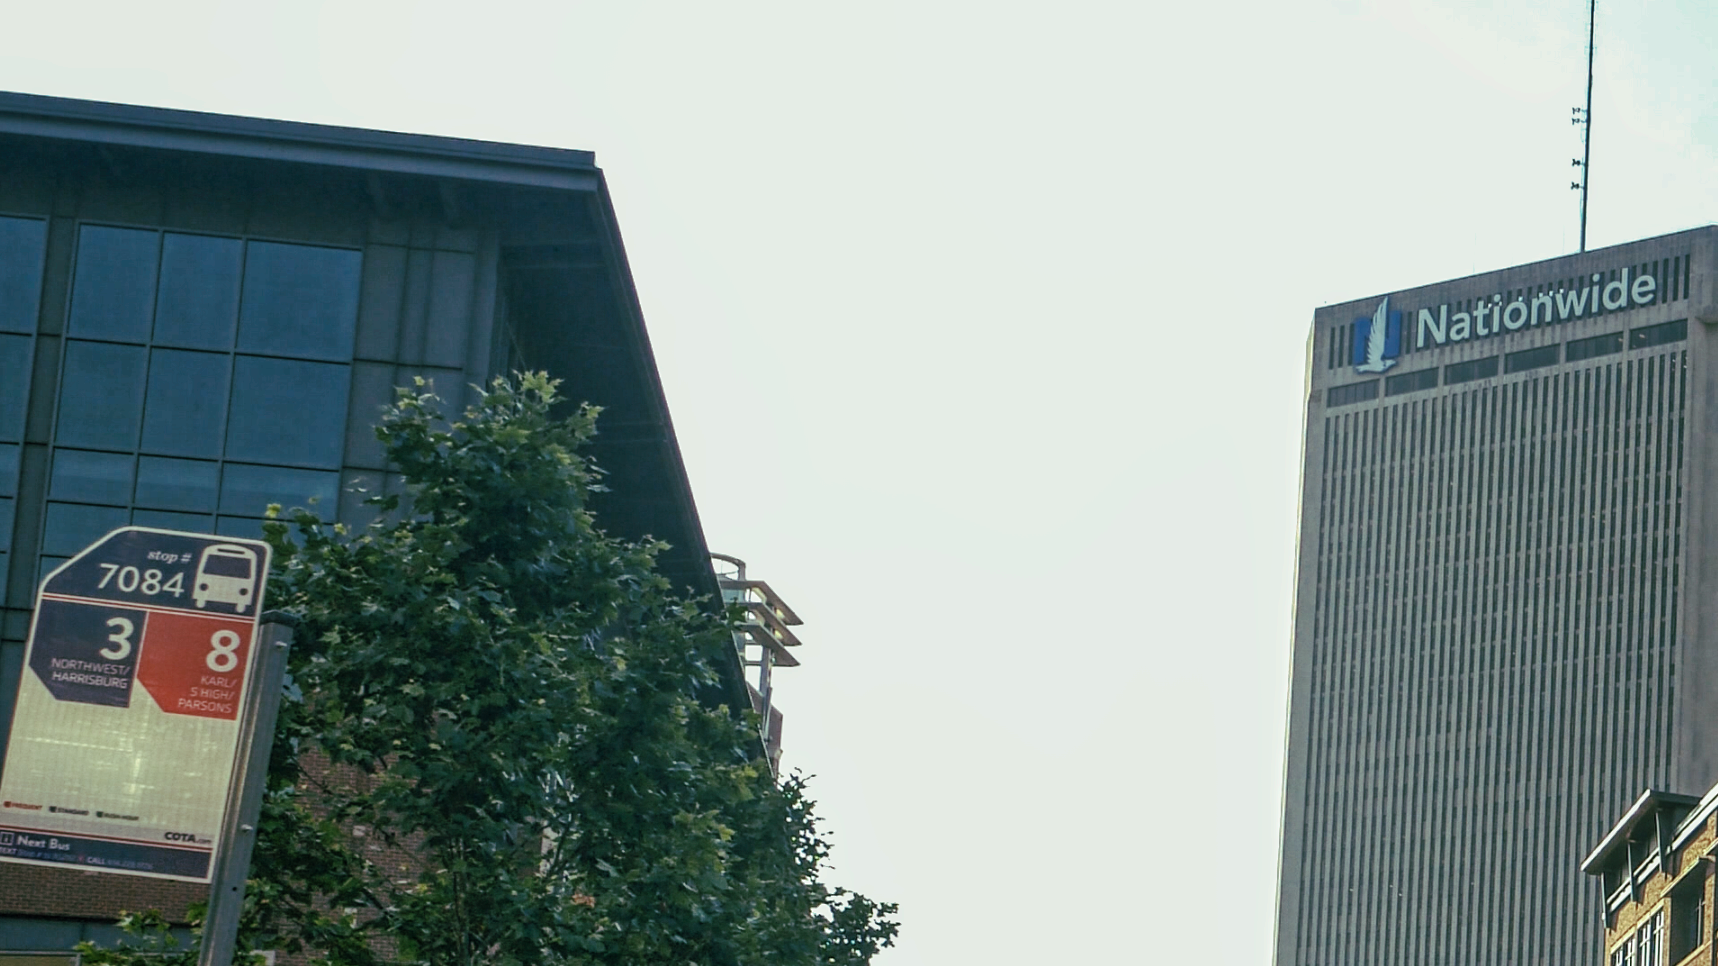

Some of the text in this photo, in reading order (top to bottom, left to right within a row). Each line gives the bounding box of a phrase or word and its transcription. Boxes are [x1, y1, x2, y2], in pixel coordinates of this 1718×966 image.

[1416, 267, 1657, 348] Nationwide
[147, 551, 179, 564] stop
[98, 563, 185, 598] 7084
[100, 617, 134, 660] 3
[206, 630, 240, 673] 8
[51, 658, 130, 676] NORTHWEST/
[52, 671, 128, 689] HARRISBURG
[201, 675, 237, 688] KARL/
[190, 686, 235, 701] S HIGH/
[178, 698, 232, 714] PARSONS
[17, 834, 70, 851] Next Bus
